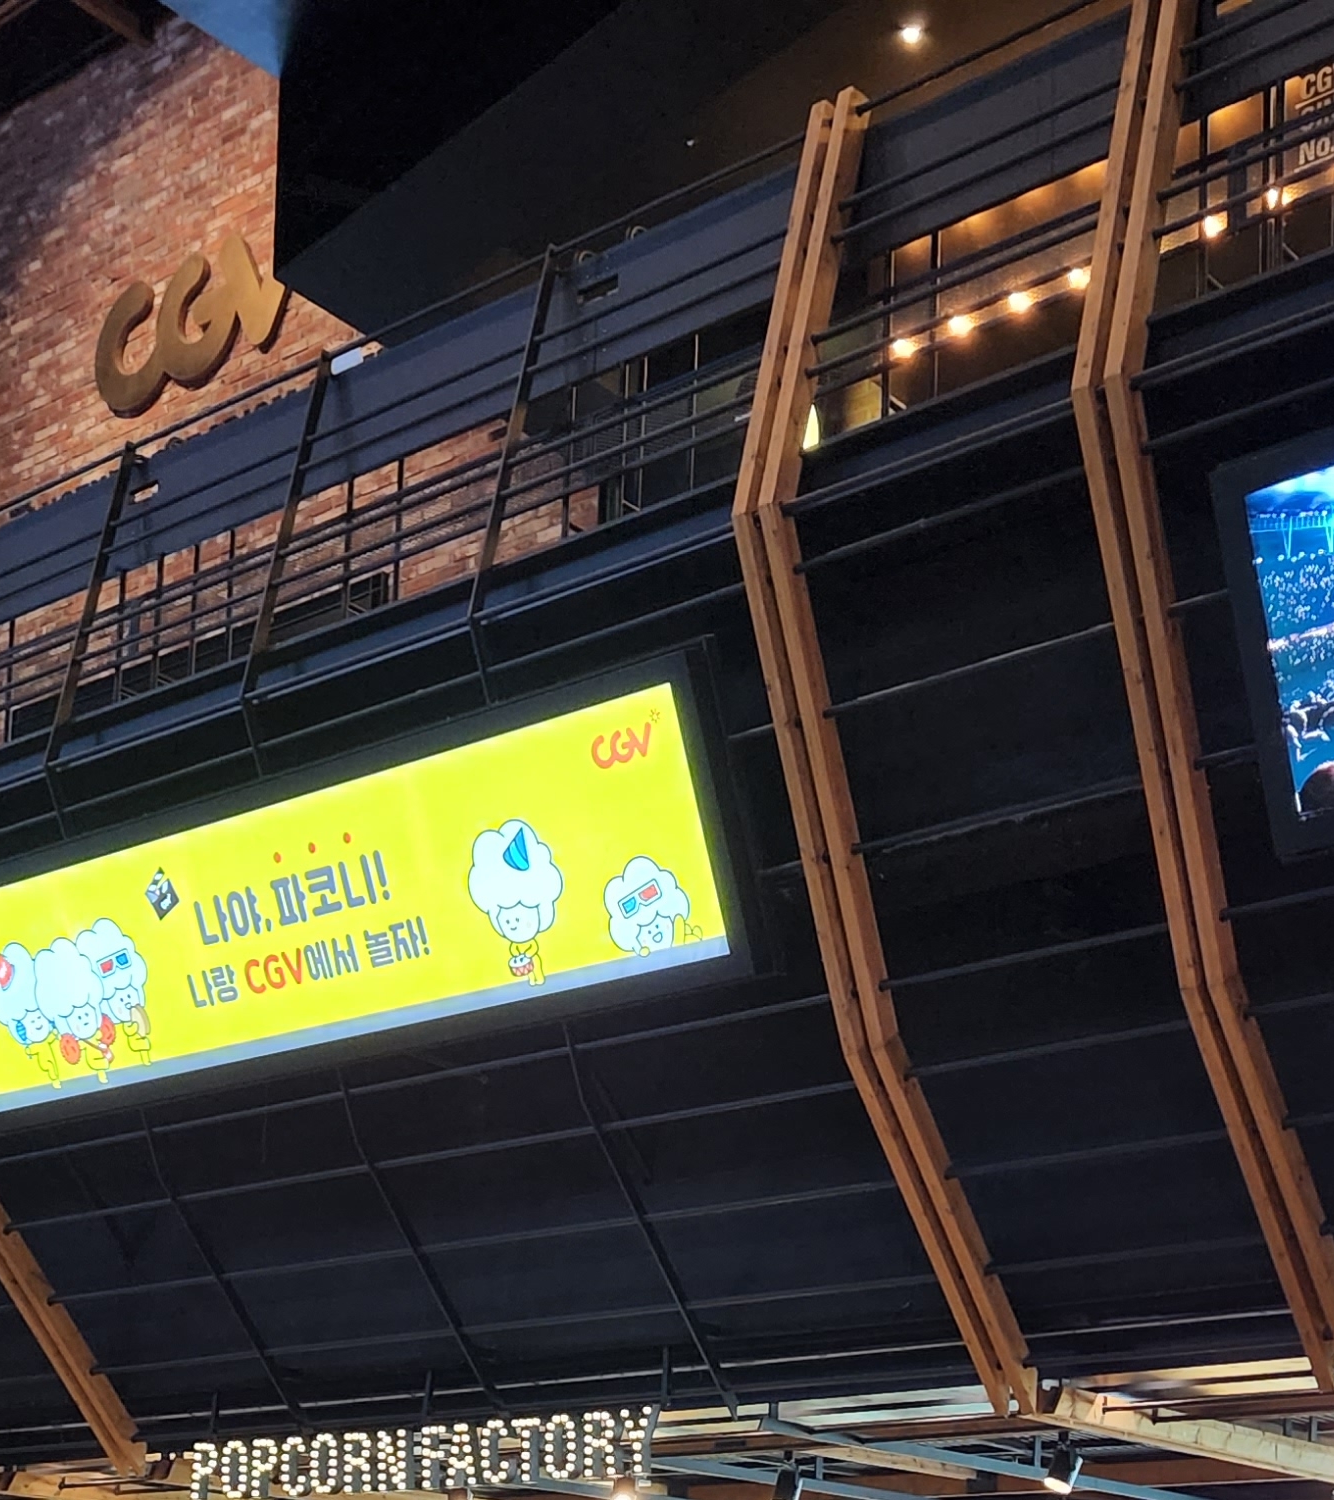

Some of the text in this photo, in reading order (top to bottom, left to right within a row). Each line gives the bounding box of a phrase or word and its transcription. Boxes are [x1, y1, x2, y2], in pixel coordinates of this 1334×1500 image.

[591, 722, 653, 770] CGV
[277, 848, 393, 928] 파코니!
[187, 915, 432, 1010] 나랑 CGV에서 놀자!
[420, 1405, 653, 1489] FACTORY
